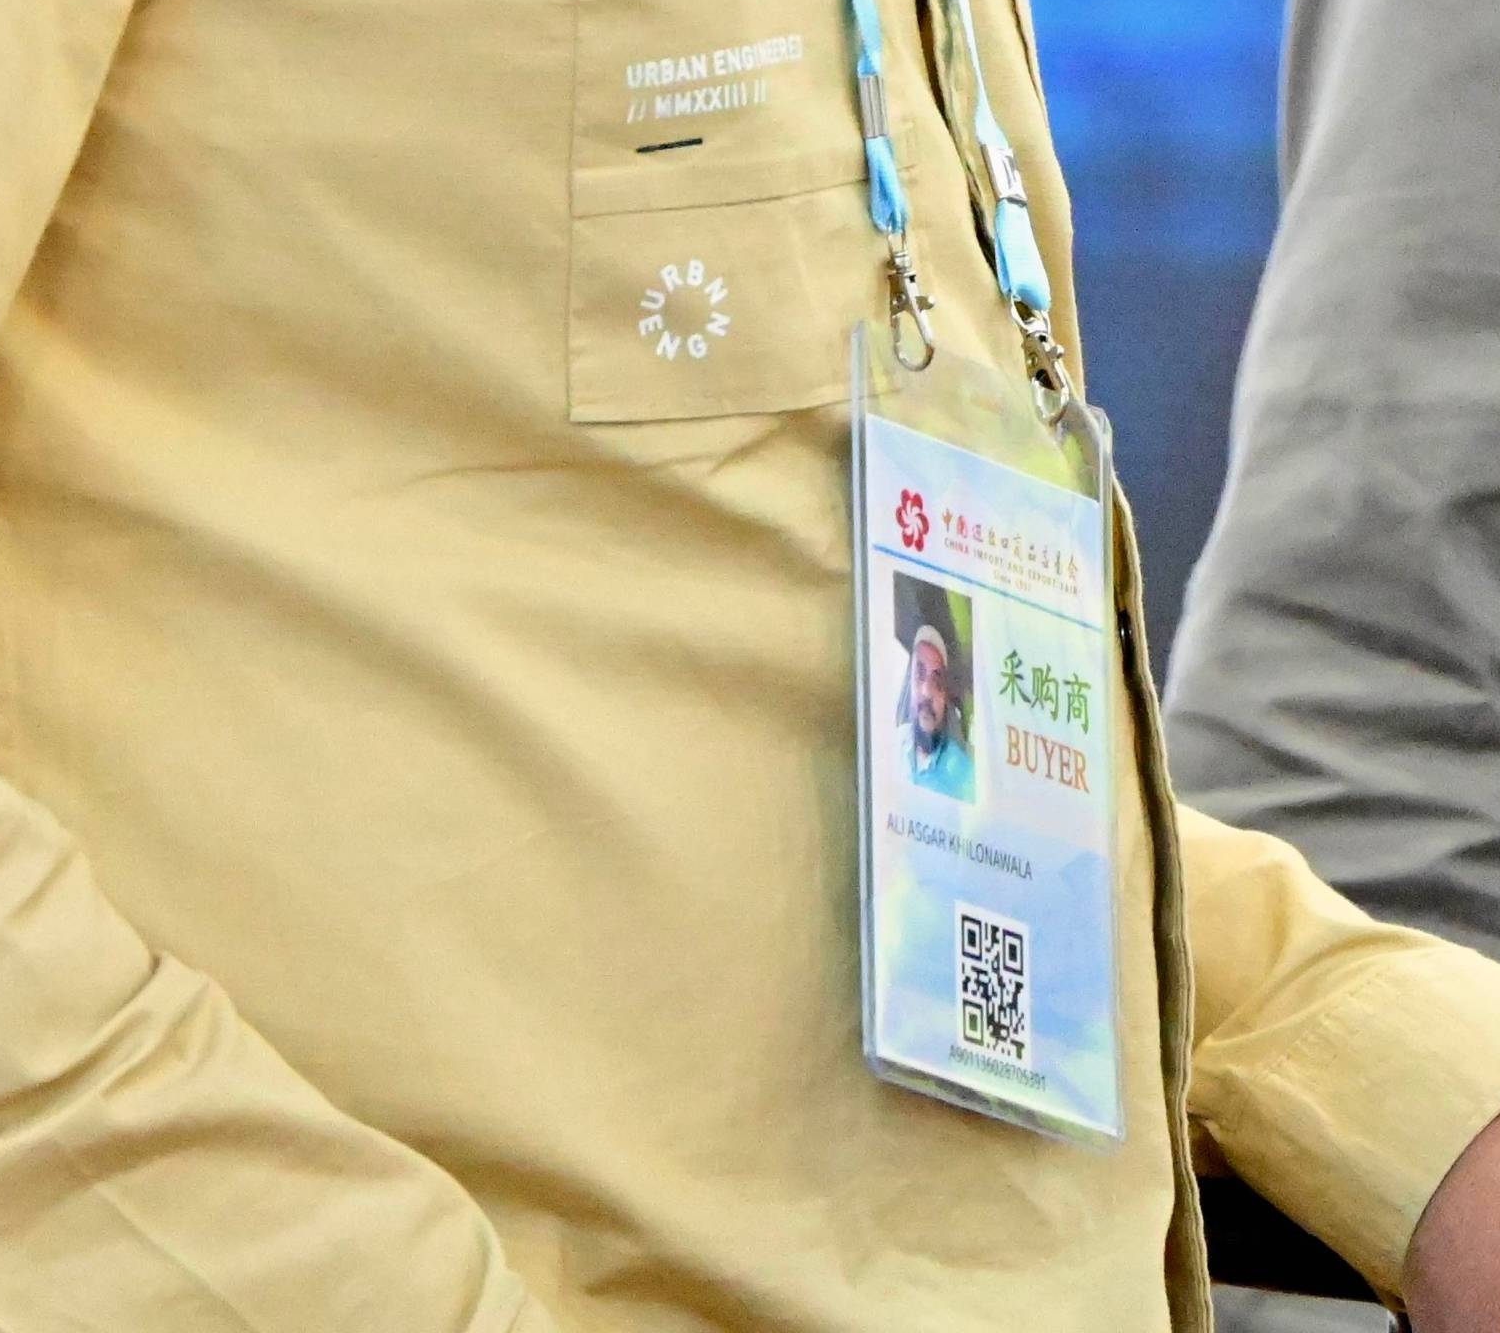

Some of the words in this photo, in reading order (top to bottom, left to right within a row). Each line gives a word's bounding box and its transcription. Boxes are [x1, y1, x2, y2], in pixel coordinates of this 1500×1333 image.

[626, 53, 708, 90] URBAN
[654, 81, 748, 120] MMXXIII
[943, 536, 970, 556] CHINA
[972, 548, 1004, 571] IMPORT
[999, 649, 1092, 735] 采购商
[1006, 724, 1090, 794] BUYER
[886, 812, 905, 835] ALI
[907, 819, 947, 853] ASGAR
[948, 832, 1034, 882] KHILONAWALA
